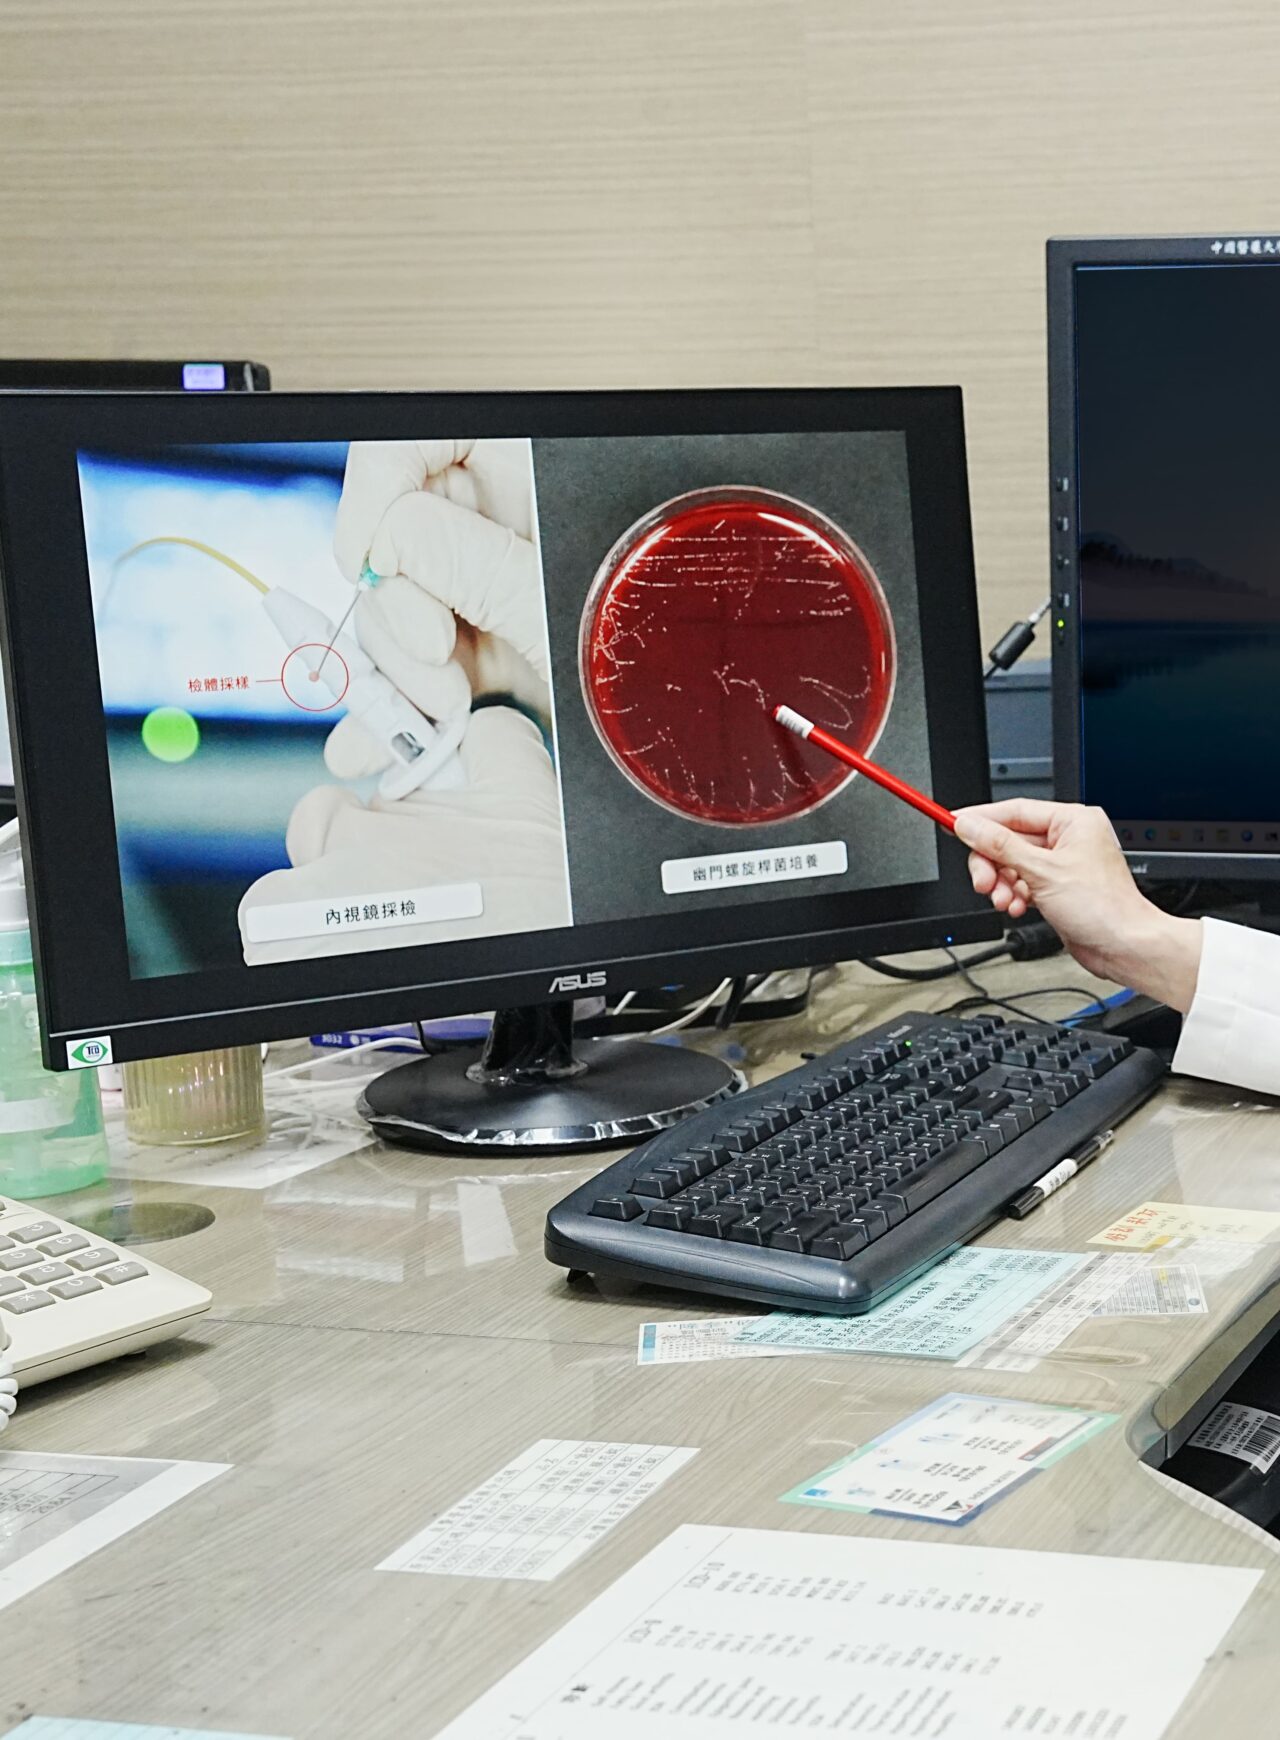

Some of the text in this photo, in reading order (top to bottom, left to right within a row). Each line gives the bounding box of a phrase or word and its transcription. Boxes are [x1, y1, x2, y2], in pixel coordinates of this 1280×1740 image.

[188, 676, 250, 693] 檢體採樣
[693, 854, 818, 881] 幽門螺旋桿菌培養
[326, 899, 416, 925] 內視鏡採檢
[549, 971, 607, 993] ASUS
